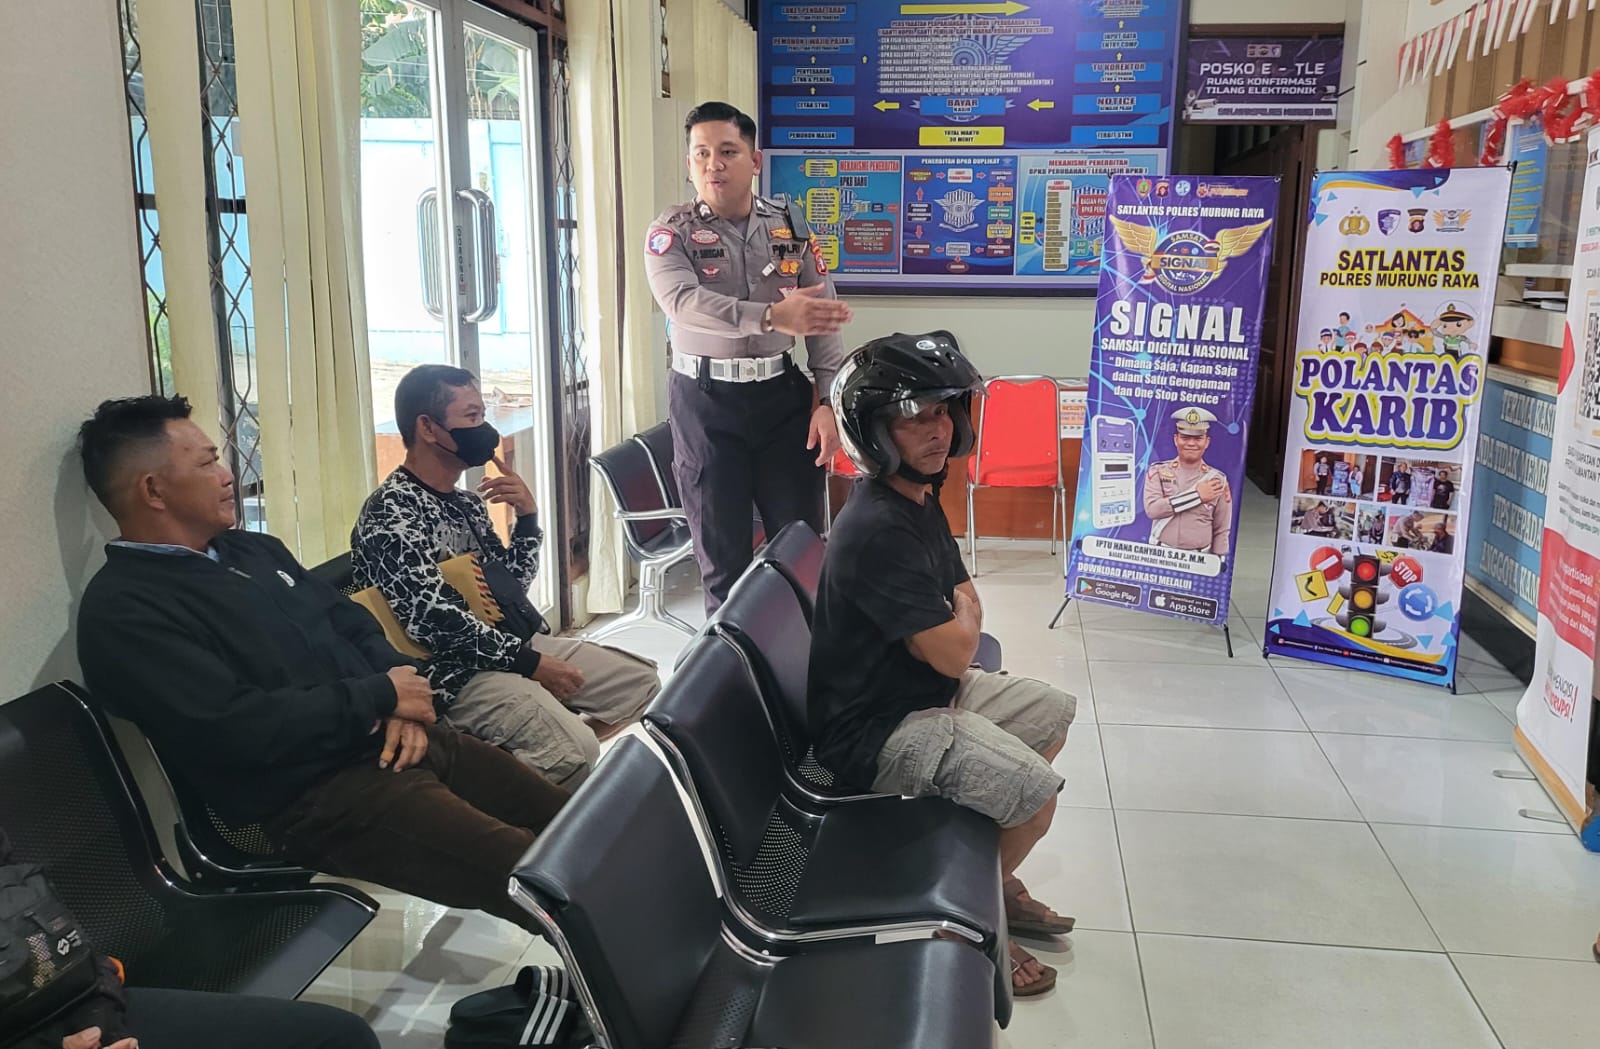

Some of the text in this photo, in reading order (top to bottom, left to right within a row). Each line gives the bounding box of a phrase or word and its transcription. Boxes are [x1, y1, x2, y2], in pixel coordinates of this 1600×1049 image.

[1104, 62, 1145, 70] KOREKTOR
[1200, 63, 1255, 75] POSKO
[1261, 63, 1272, 74] E
[1295, 62, 1325, 75] TLE
[1205, 86, 1316, 94] TILANG ELEKTRONIK
[1206, 77, 1317, 85] RUANG KONFIRMASI
[947, 98, 978, 107] BAYAR
[1097, 97, 1136, 105] NOTICE
[1117, 205, 1264, 219] SATLANTAS POLRES MURUNG RAYA
[1170, 232, 1204, 243] SAMSAT
[1159, 257, 1209, 269] SIGNAL
[1338, 250, 1465, 272] SATLANTAS
[1158, 273, 1210, 293] DIGITAL NASIONAL
[1319, 272, 1479, 288] POLRES MURUNG RAYA
[1109, 300, 1245, 343] SIGNAL
[1101, 337, 1249, 360] SAMSAT DIGITAL NASIONAL
[1154, 359, 1178, 373] Saja,
[1180, 362, 1213, 375] Kapan
[1214, 365, 1238, 377] Saja
[1300, 358, 1479, 396] POLANTAS
[1112, 371, 1231, 391] dalam Satu Genggaman
[1113, 385, 1219, 405] dan One Stop Service
[1310, 391, 1458, 440] KARIB
[1501, 389, 1535, 430] TERIMA
[1493, 439, 1521, 481] TIDAK
[1492, 493, 1511, 531] TIPS
[1508, 502, 1544, 552] KEPADA
[1096, 539, 1112, 551] IPTU
[1113, 542, 1133, 553] HANA
[1189, 555, 1206, 565] M.M.
[1077, 562, 1192, 590] DOWNLOAD APLIKASI MELALUI
[1394, 561, 1417, 583] STOP
[1480, 540, 1520, 594] ANGGOTA
[1095, 588, 1136, 602] Google Play
[1170, 594, 1194, 604] Download
[1169, 602, 1211, 616] App Store
